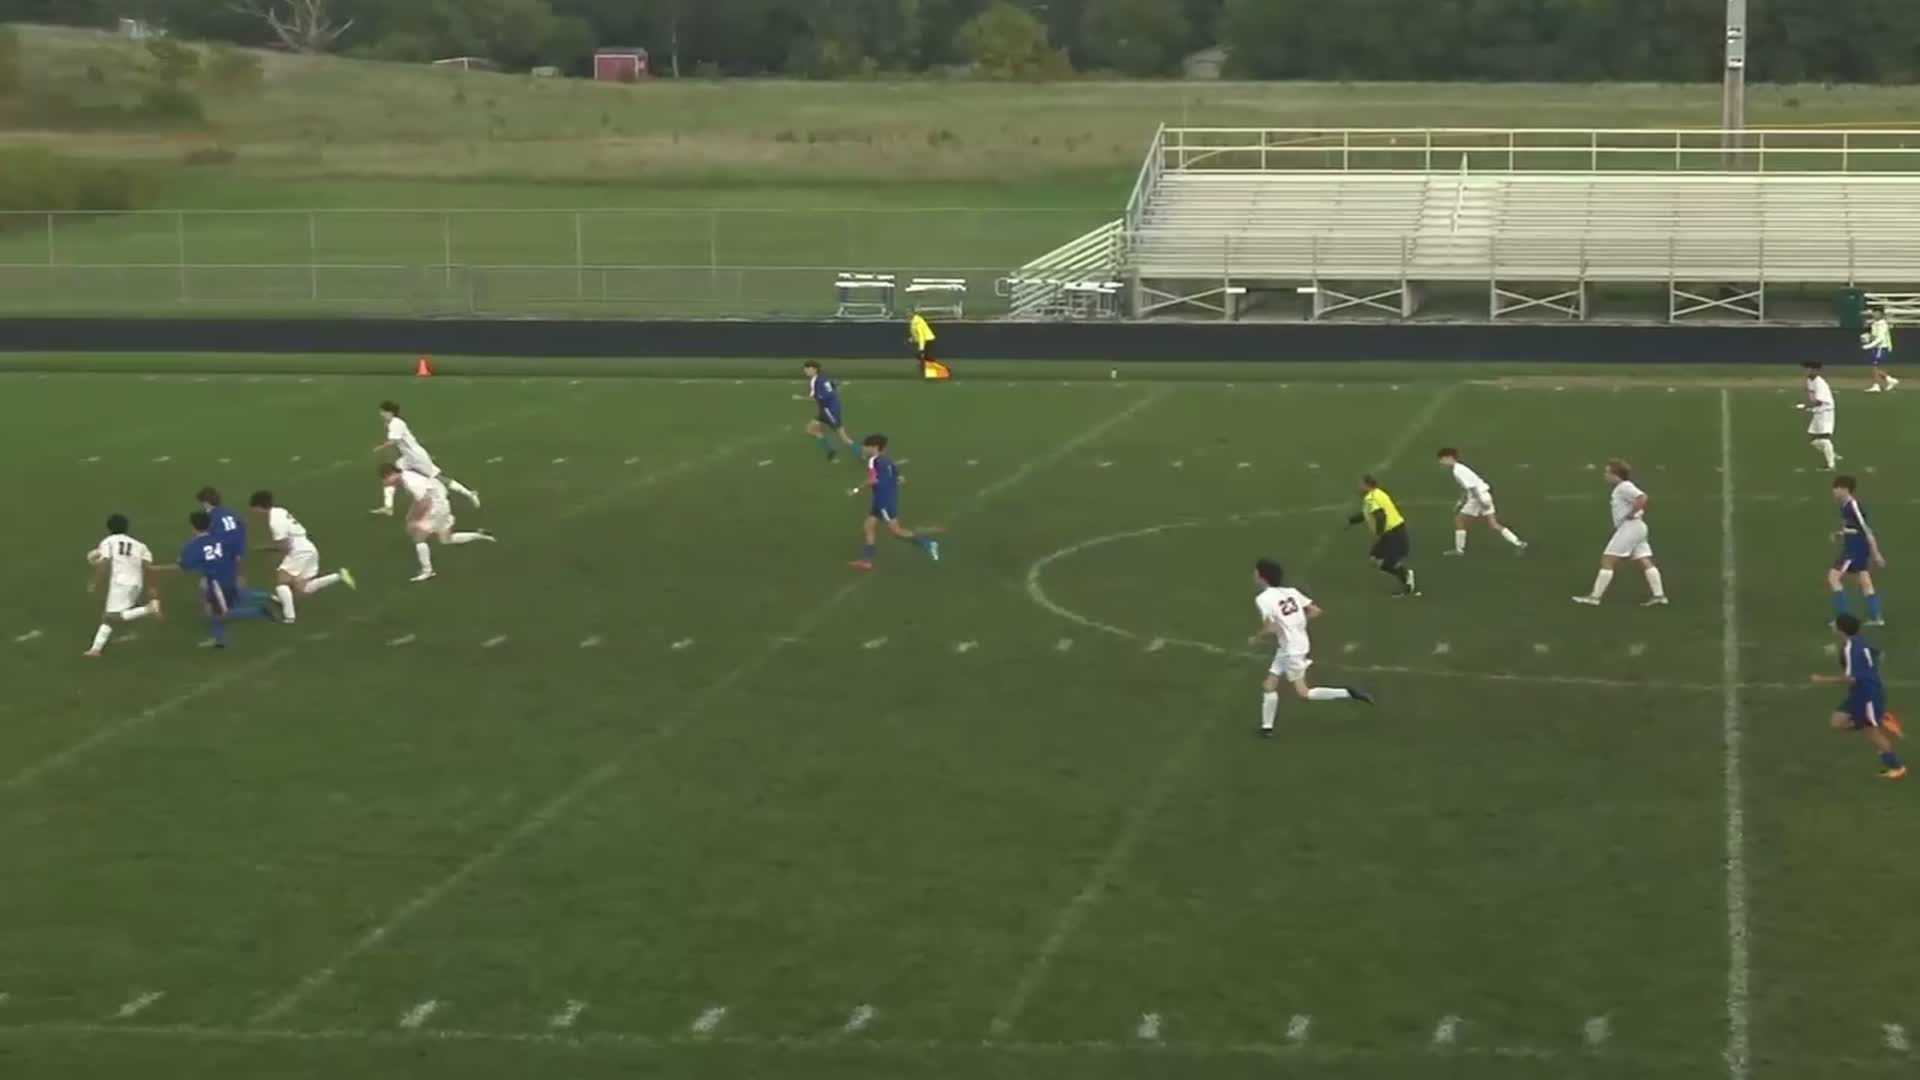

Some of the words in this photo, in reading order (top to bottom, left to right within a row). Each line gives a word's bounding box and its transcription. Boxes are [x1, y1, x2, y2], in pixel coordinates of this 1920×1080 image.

[118, 540, 133, 557] 11
[203, 541, 224, 561] 24
[1278, 596, 1299, 617] 23
